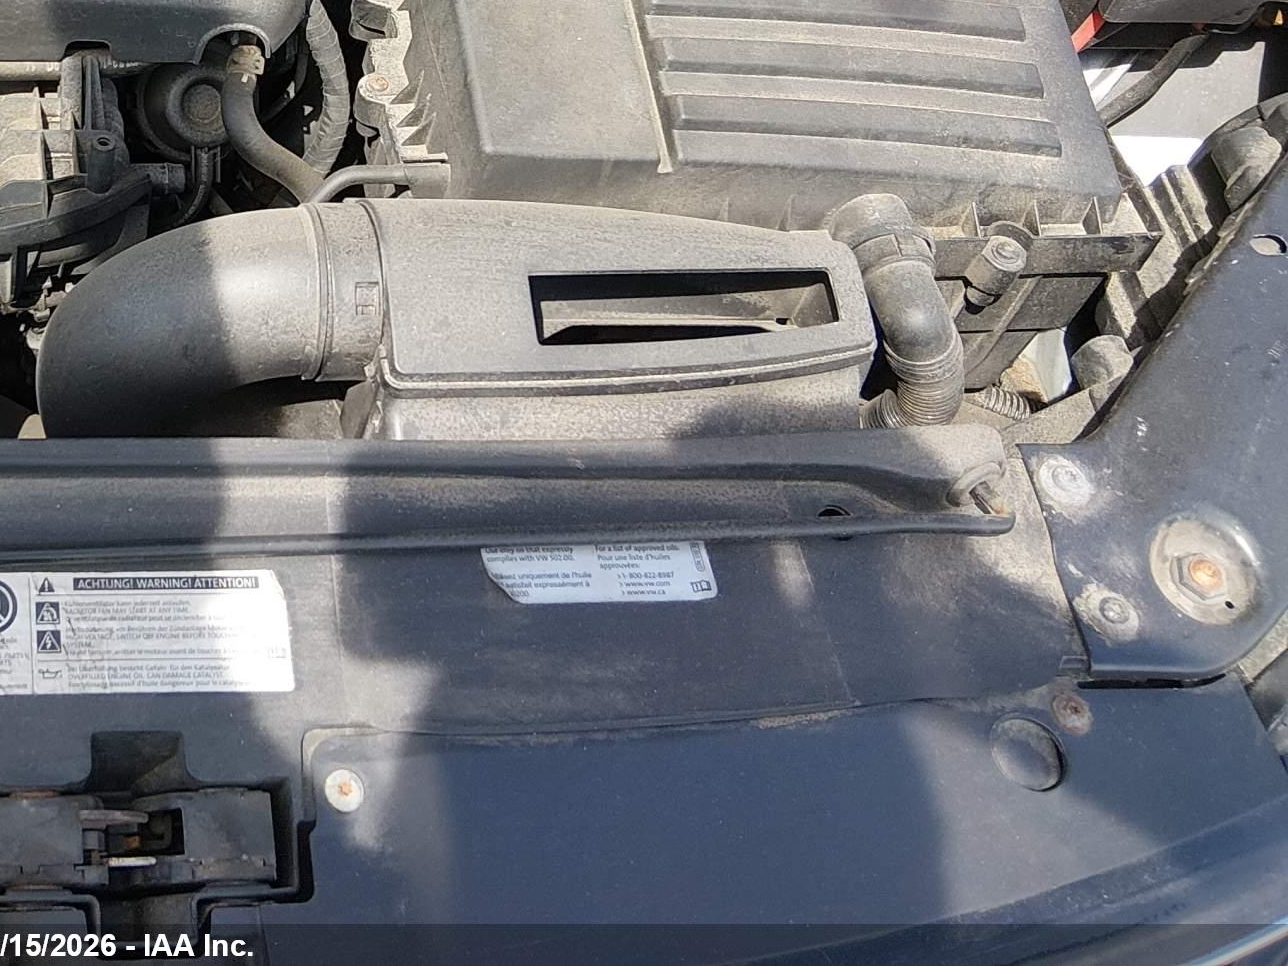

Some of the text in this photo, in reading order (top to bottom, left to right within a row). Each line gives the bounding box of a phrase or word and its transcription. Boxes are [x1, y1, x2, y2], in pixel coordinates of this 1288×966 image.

[634, 543, 665, 552] approved
[518, 572, 560, 581] uniquement
[77, 576, 256, 589] ACHTUNG! WARNING! ATTENTION!
